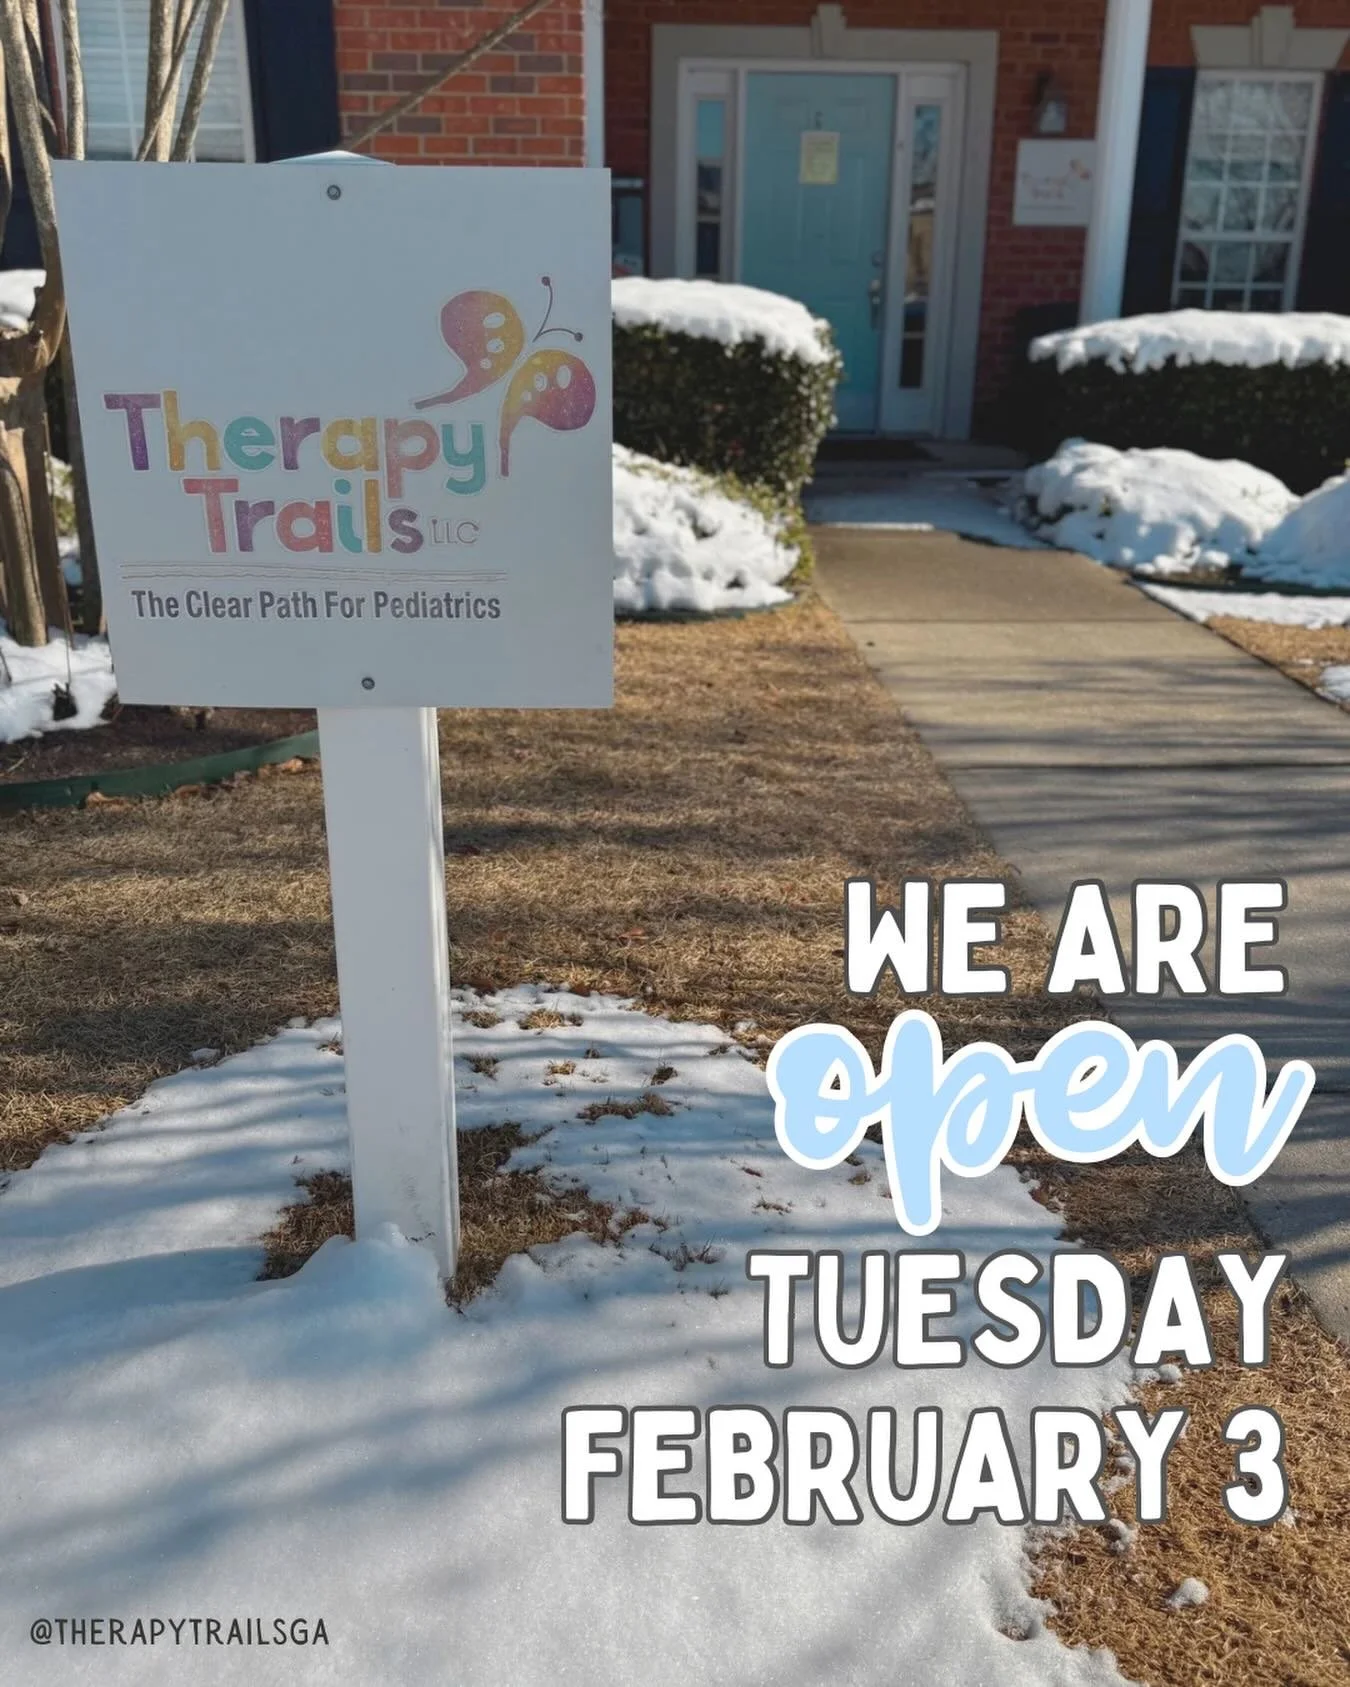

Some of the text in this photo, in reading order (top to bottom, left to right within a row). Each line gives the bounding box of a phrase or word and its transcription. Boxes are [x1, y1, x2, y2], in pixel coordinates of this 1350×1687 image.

[104, 390, 486, 498] Therapy
[183, 478, 479, 554] Trails LLC
[131, 590, 501, 620] The Clear Path For Pediatrics
